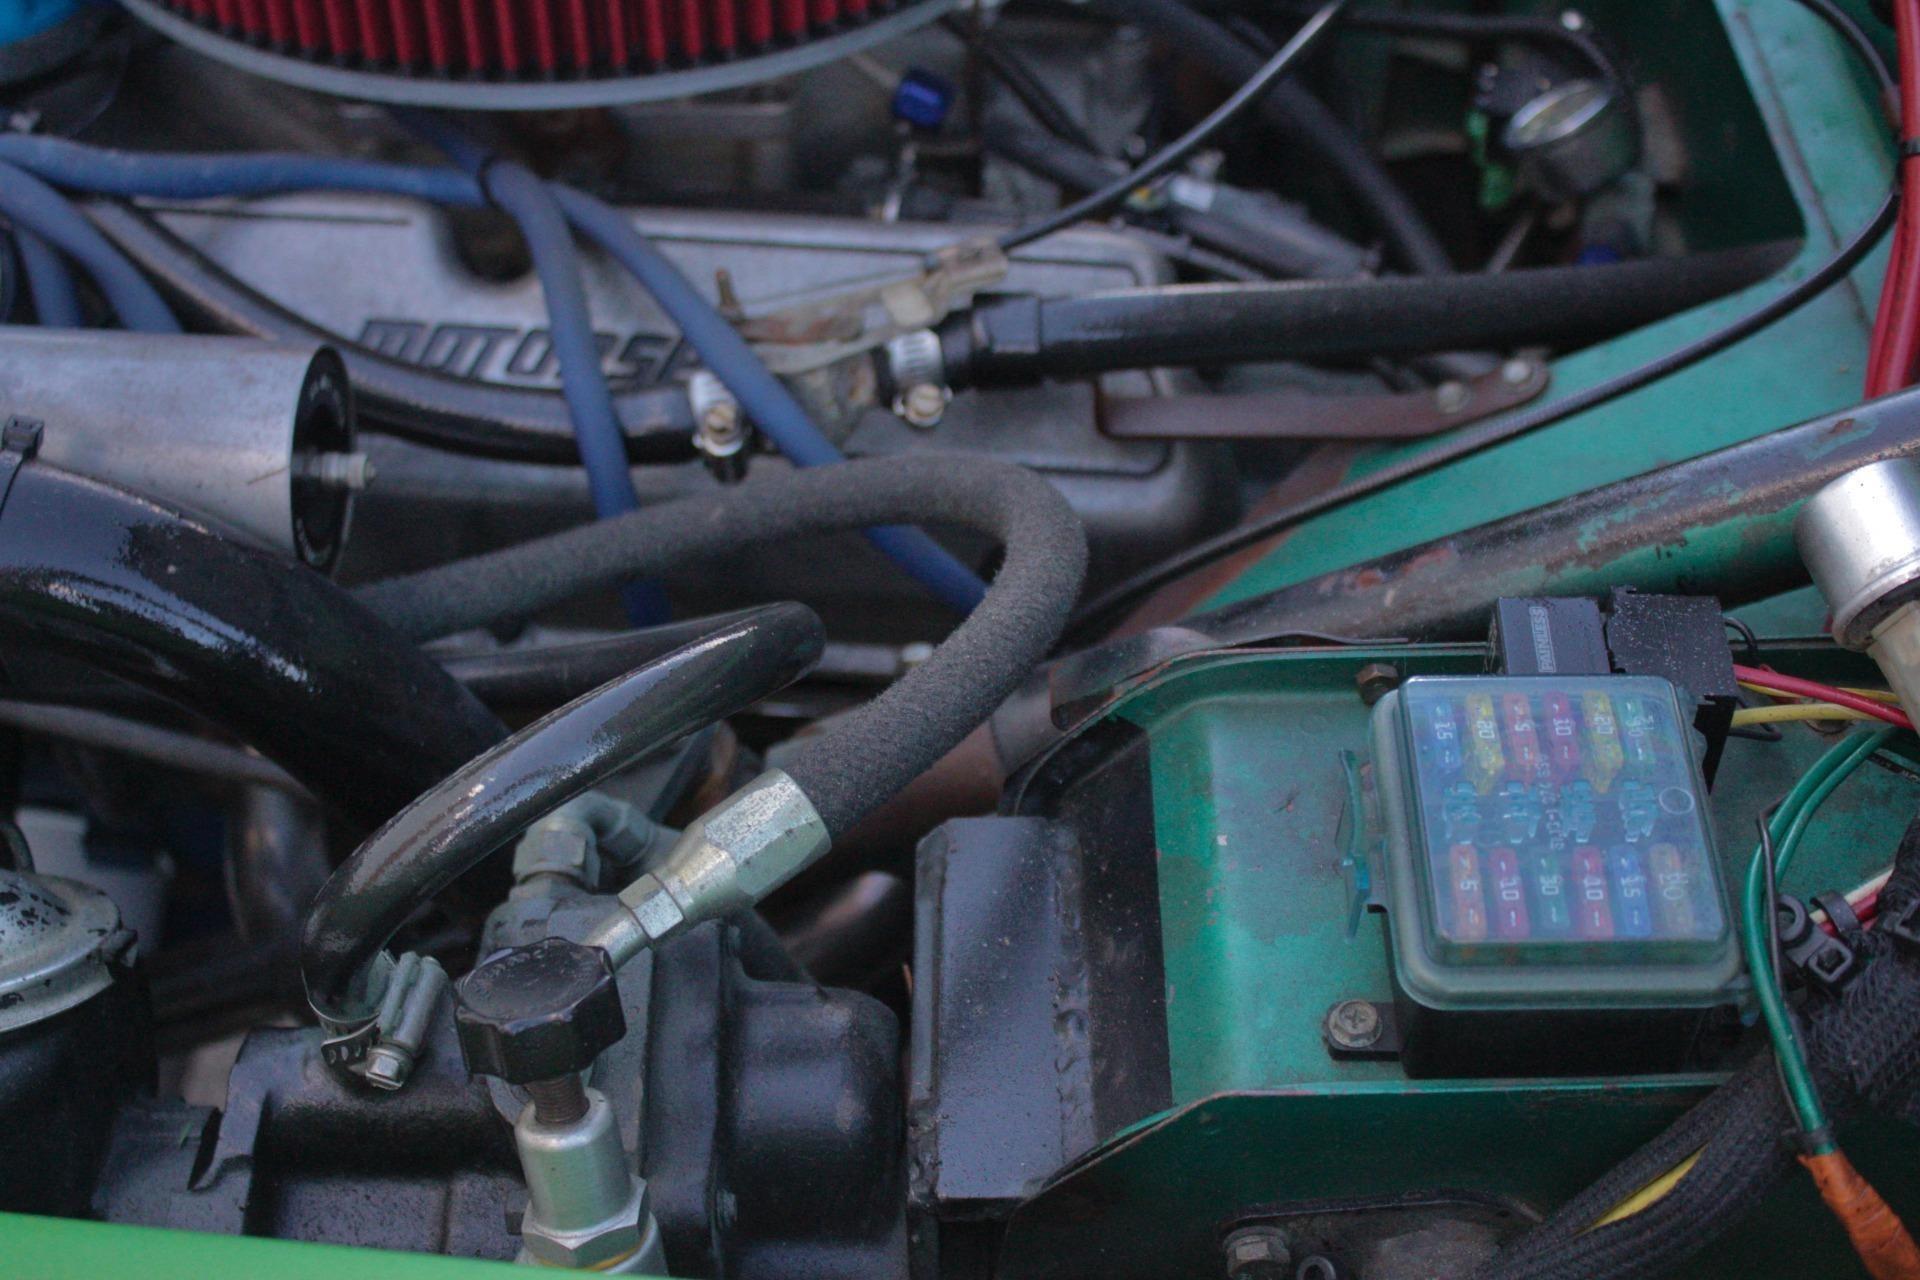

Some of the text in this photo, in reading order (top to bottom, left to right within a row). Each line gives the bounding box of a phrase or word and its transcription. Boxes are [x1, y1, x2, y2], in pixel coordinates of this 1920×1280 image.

[1530, 607, 1555, 672] PAINLESS
[1434, 720, 1455, 740] 15
[1476, 719, 1496, 740] 20
[1553, 717, 1573, 737] 10
[1499, 876, 1520, 901] 10
[1583, 875, 1604, 901] 10
[1620, 875, 1645, 899] 15
